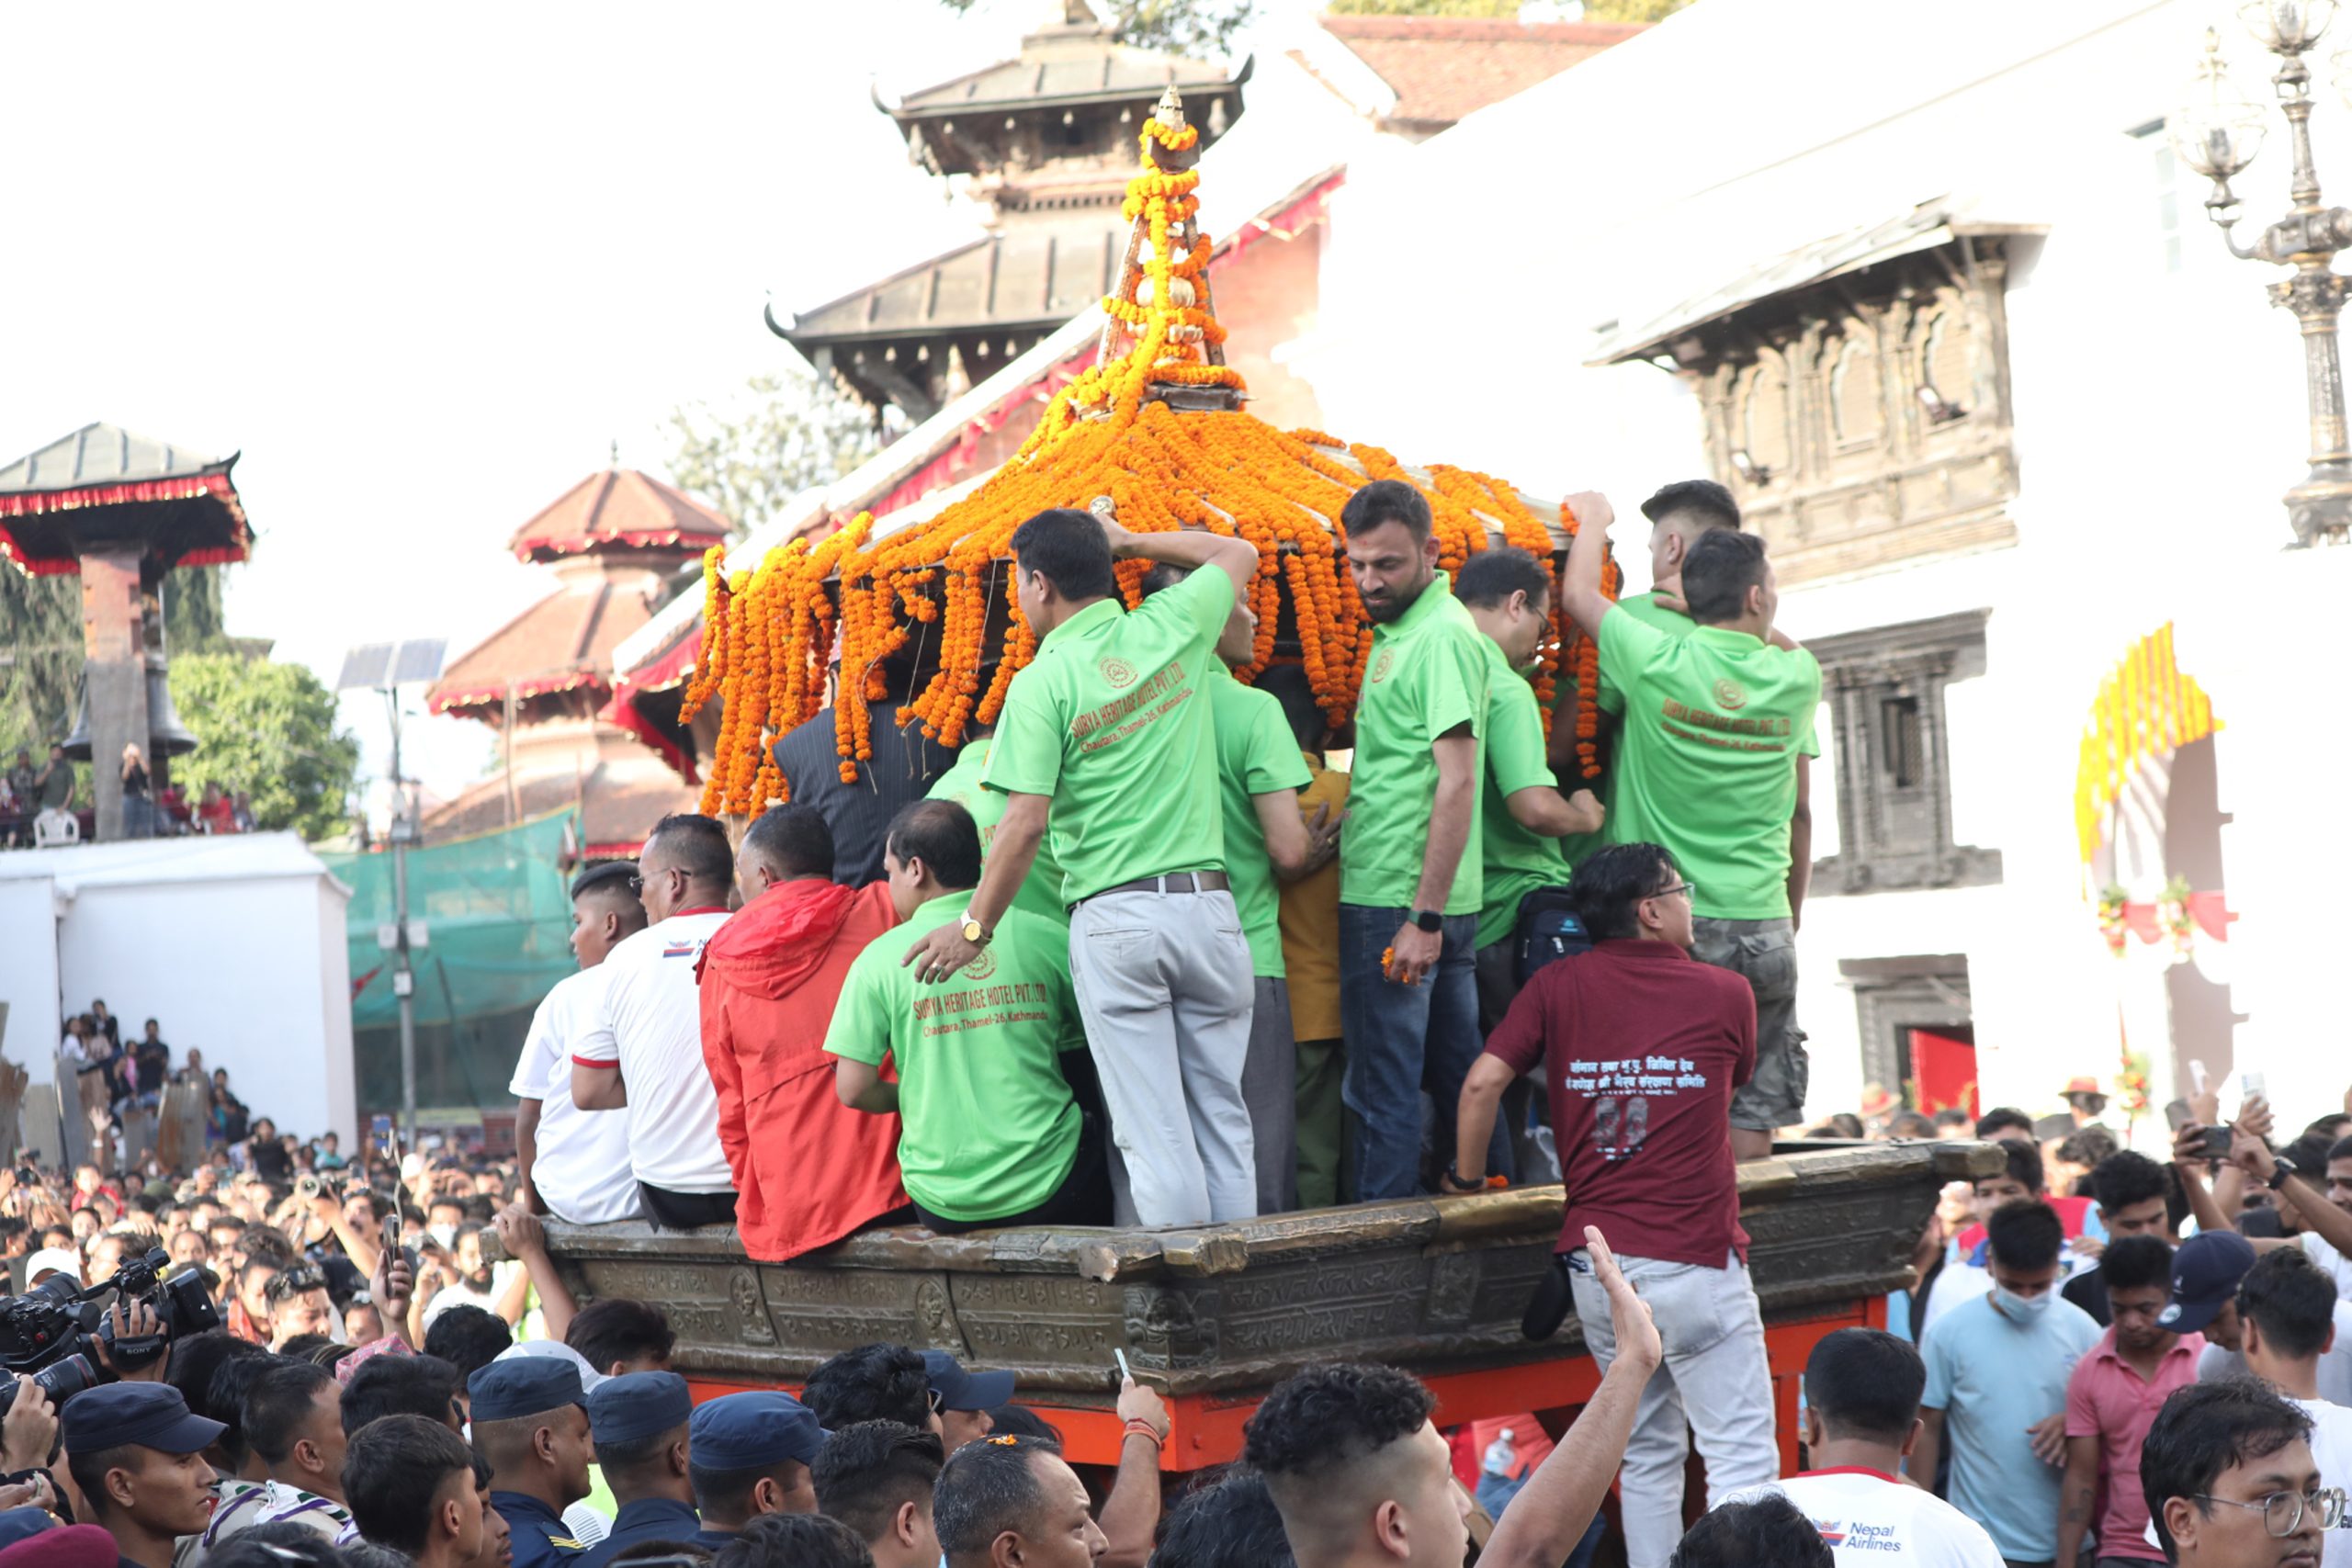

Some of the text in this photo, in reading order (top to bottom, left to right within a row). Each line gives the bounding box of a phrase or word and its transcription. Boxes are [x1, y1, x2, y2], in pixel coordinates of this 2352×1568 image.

[1070, 710, 1102, 739] SURYA
[1099, 693, 1136, 727] HERITAGE
[913, 996, 944, 1021] SURYA
[944, 988, 987, 1015] HERITAGE
[987, 984, 1014, 1007] HOTEL
[922, 1010, 1048, 1038] Chautara, Thamel-26, Kathmandu
[126, 1347, 151, 1355] SONY
[1849, 1522, 1894, 1538] Nepal
[1846, 1535, 1902, 1552] Airlines
